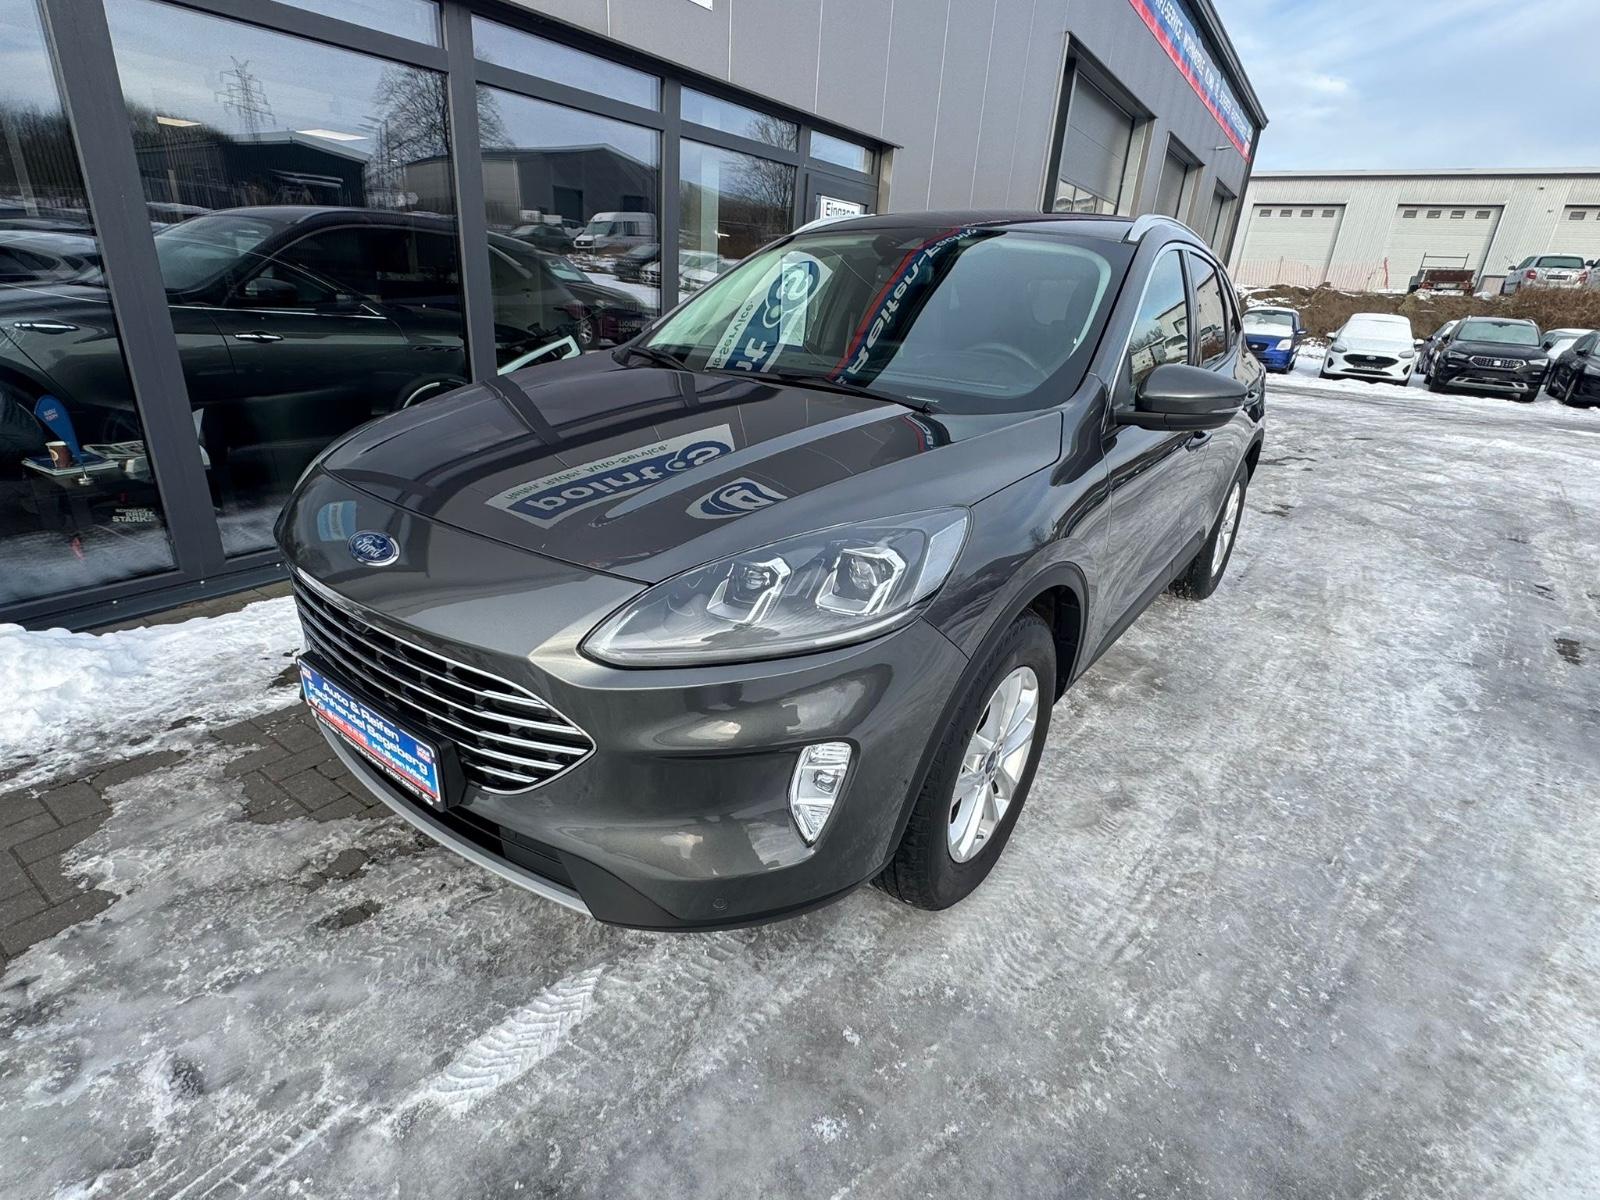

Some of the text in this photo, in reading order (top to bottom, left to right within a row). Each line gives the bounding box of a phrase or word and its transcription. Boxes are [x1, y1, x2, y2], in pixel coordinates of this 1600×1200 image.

[357, 535, 387, 558] Ford
[307, 681, 366, 730] Fachhandel
[366, 724, 428, 776] Segeberg
[322, 682, 349, 707] Auto
[349, 701, 361, 715] &
[360, 708, 400, 742] Reifen
